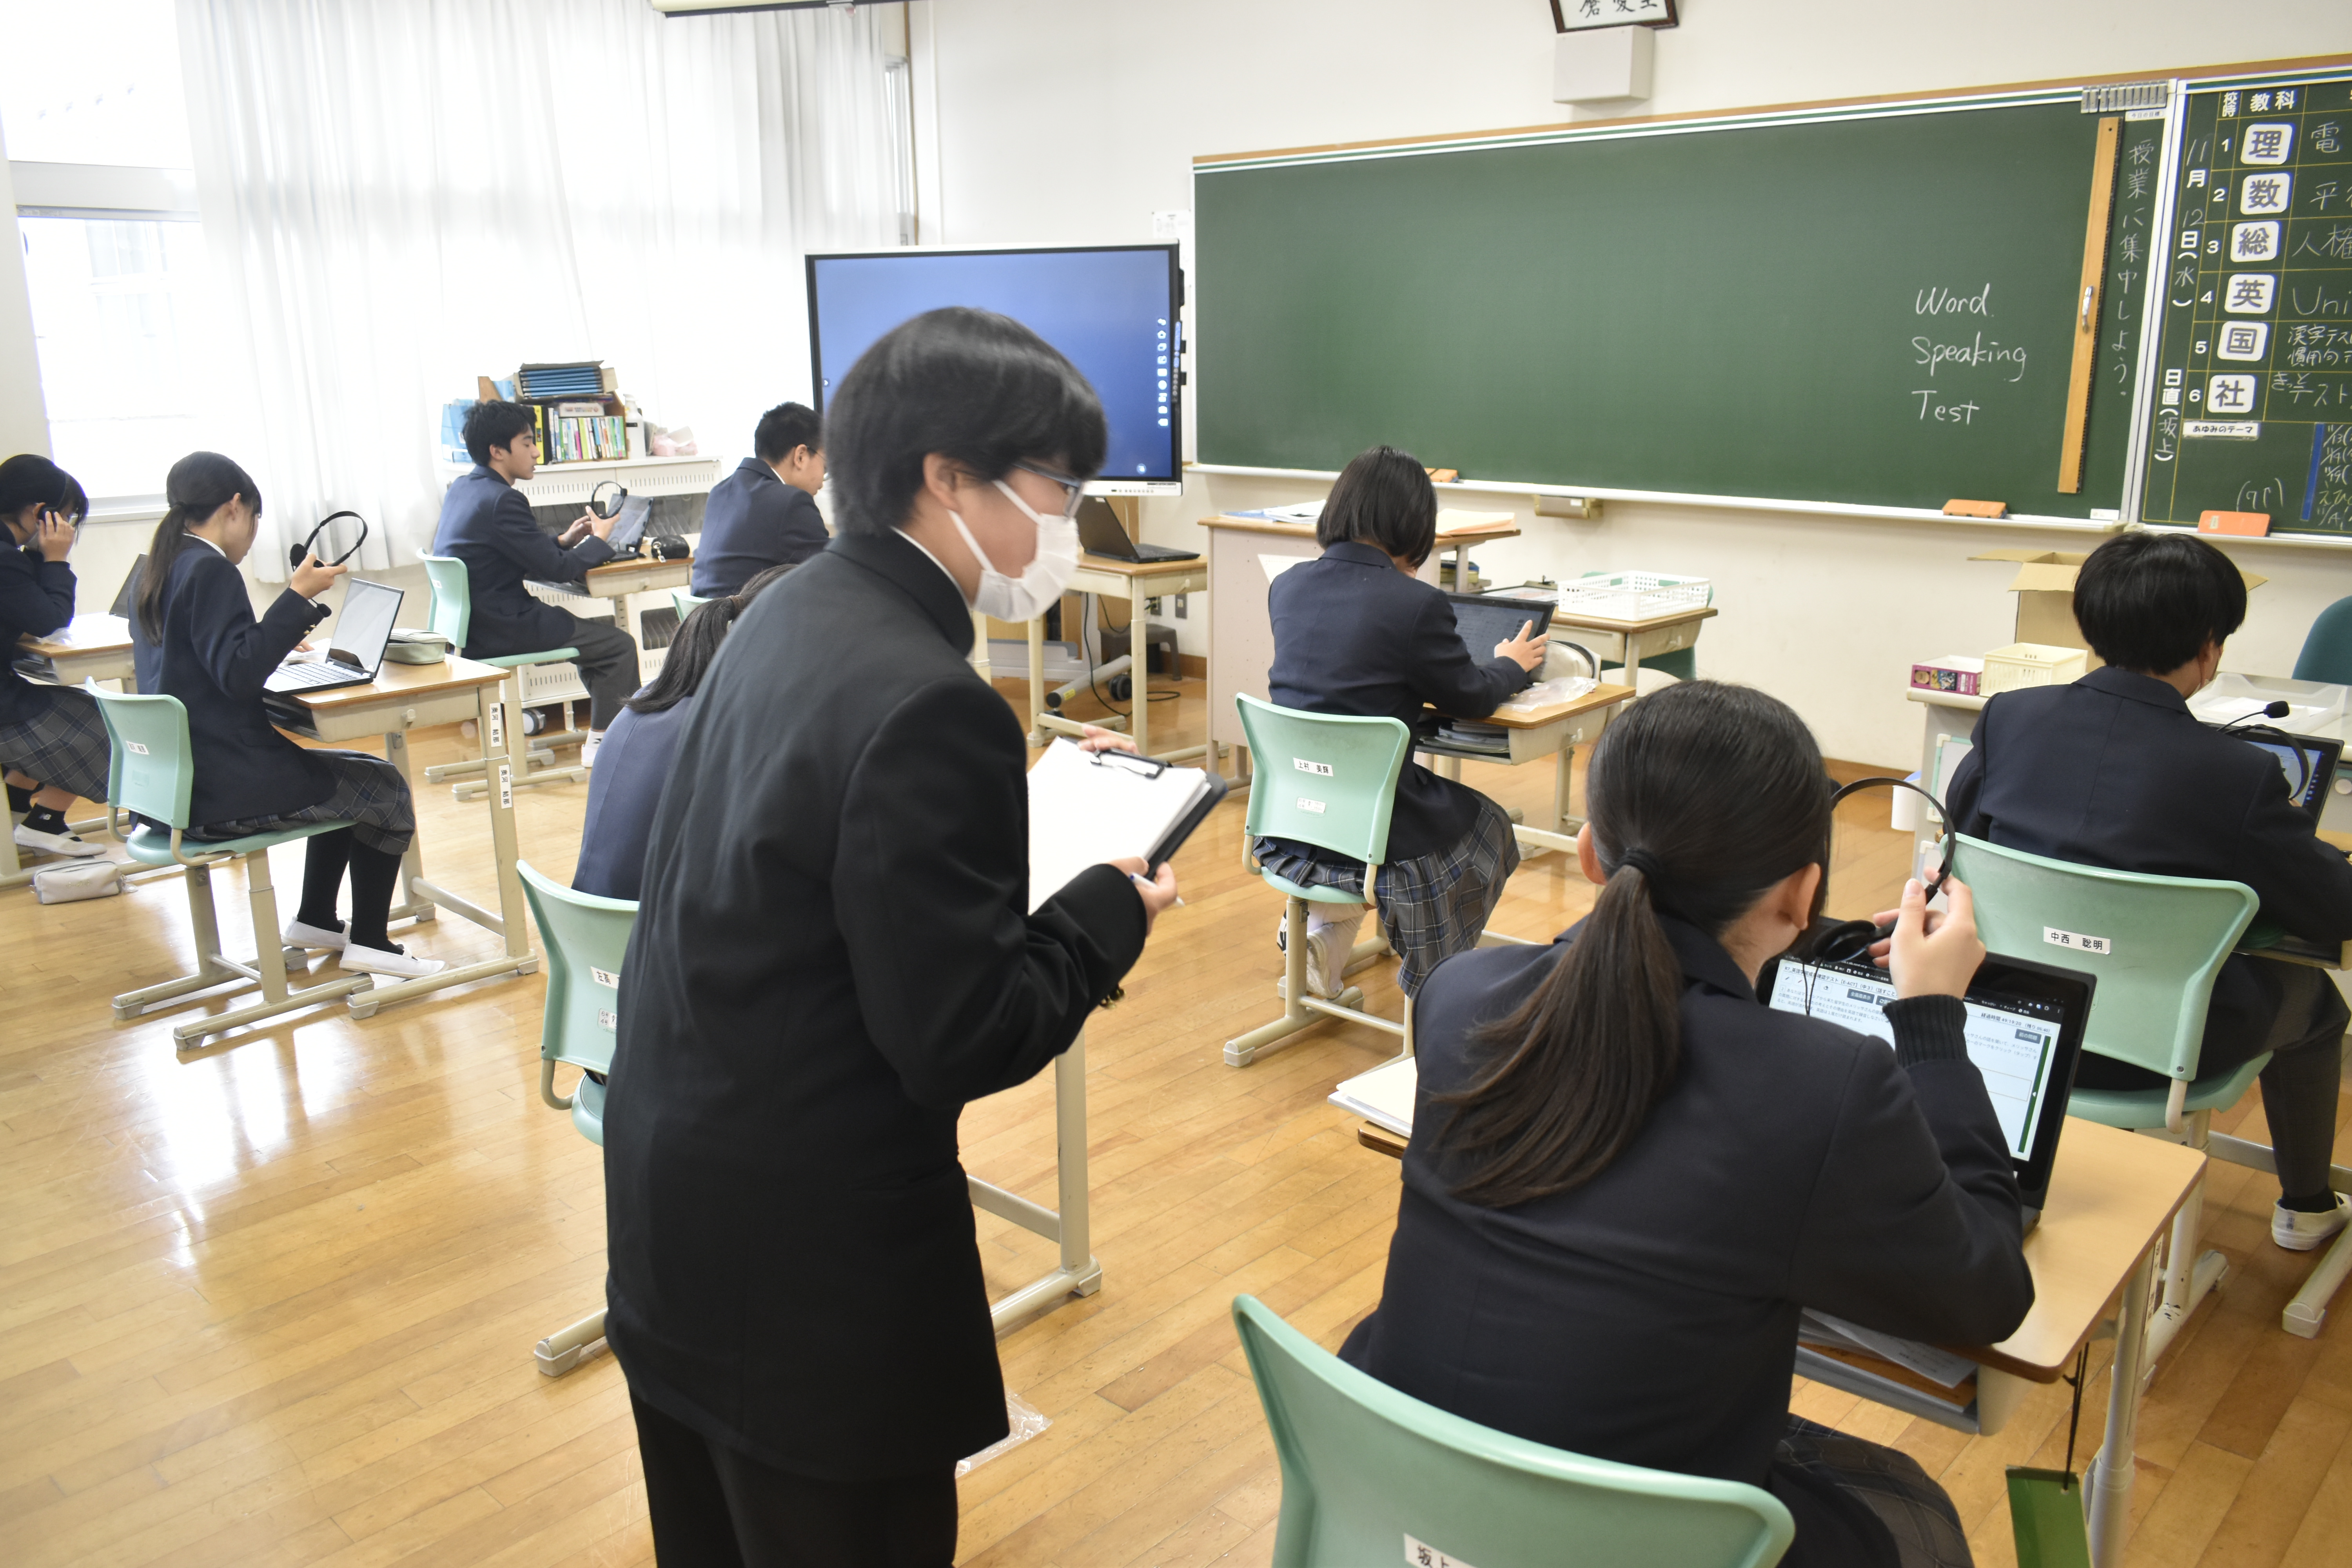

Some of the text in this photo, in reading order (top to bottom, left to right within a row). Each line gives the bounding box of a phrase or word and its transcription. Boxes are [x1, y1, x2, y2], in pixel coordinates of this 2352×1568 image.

[2222, 92, 2238, 118] 校時
[2250, 91, 2295, 113] 教科
[2221, 138, 2230, 152] 1
[2249, 131, 2282, 158] 理
[2311, 122, 2339, 154] 電
[2213, 189, 2226, 202] 2
[2248, 179, 2281, 209] 数
[2207, 240, 2219, 254] 3
[2238, 228, 2270, 256] 総
[1916, 283, 1990, 315] Word
[2200, 292, 2212, 304] 4
[2232, 280, 2265, 308] 英
[2195, 341, 2206, 354] 5
[2226, 328, 2258, 354] 国
[1911, 331, 2027, 382] Speaking
[2189, 389, 2201, 402] 6
[2215, 380, 2245, 407] 社
[1911, 390, 1980, 425] Test
[2193, 425, 2253, 434] あゆみのテーマ
[2051, 931, 2102, 950] 中西 聡明
[1981, 1013, 2001, 1022] 経過時間
